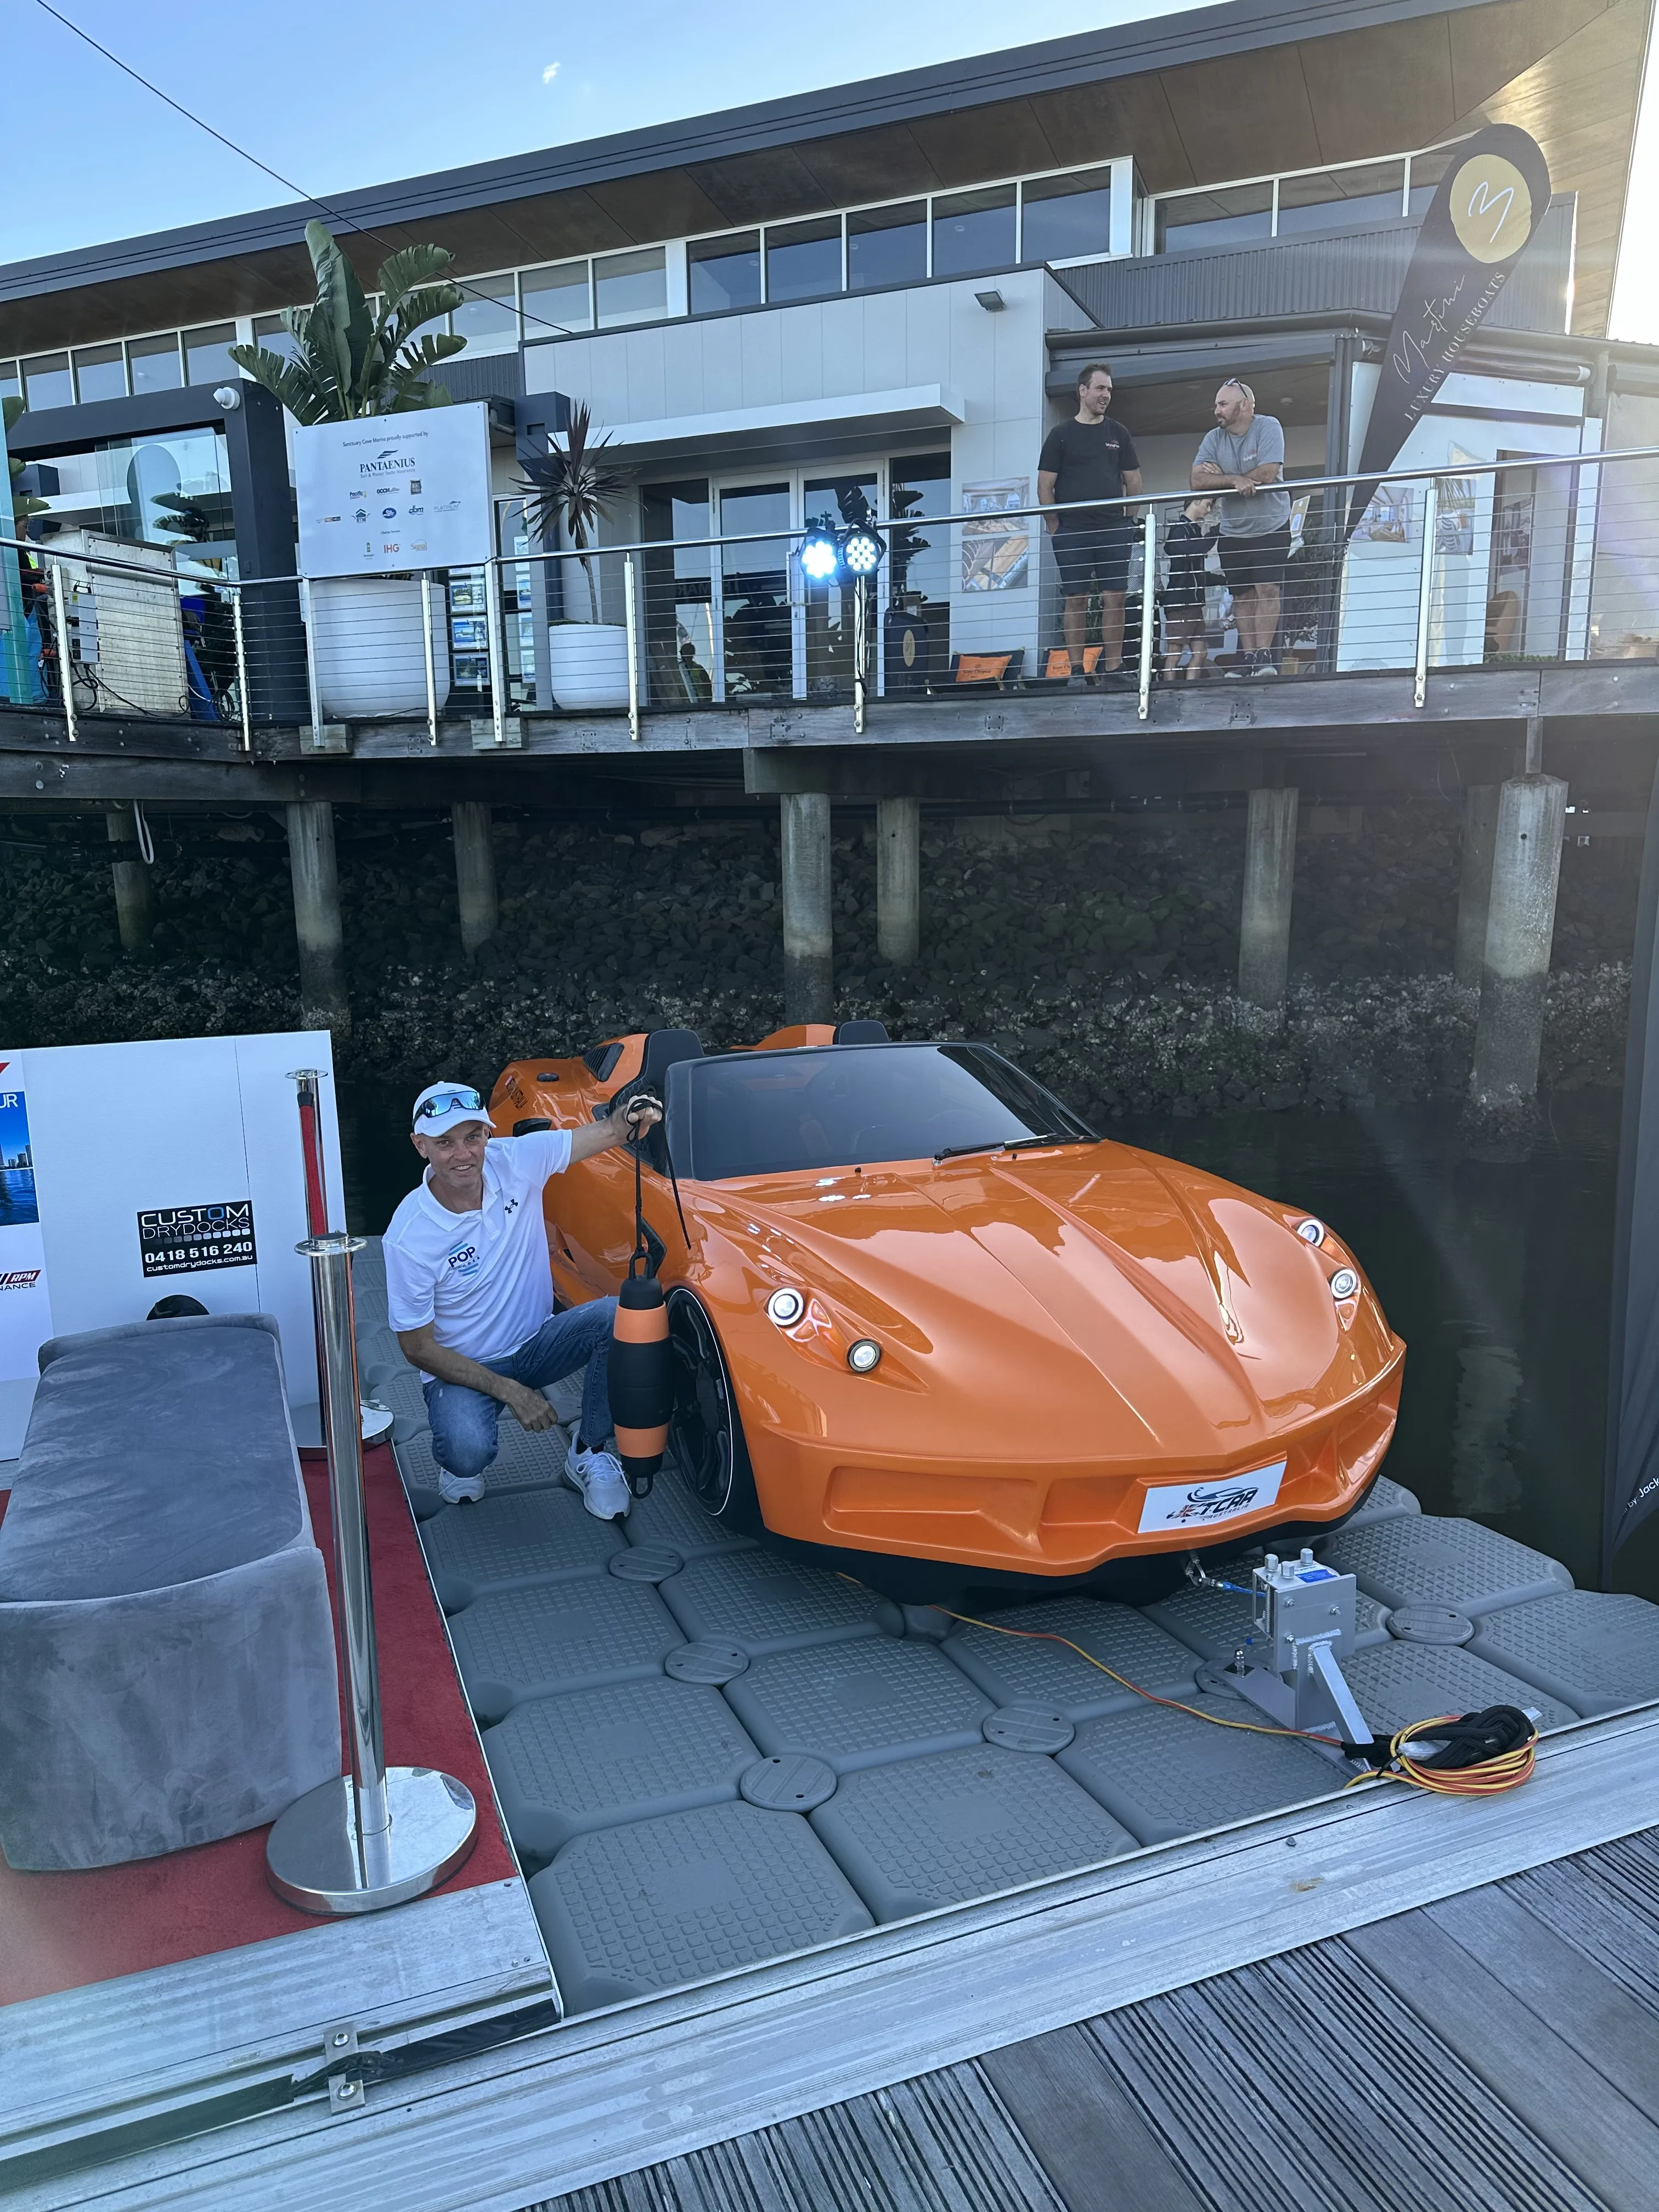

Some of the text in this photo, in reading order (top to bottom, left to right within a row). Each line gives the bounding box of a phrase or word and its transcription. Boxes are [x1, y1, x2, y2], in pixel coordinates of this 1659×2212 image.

[1393, 274, 1465, 384] Martini
[1404, 272, 1505, 421] LUXURY HOUSEBOATS
[402, 431, 422, 439] supported
[359, 457, 415, 472] PANTAENIUS
[384, 543, 400, 554] IHG
[141, 1203, 249, 1227] CUSTOM
[142, 1217, 250, 1239] DRYDOCKS
[145, 1242, 252, 1263] 0418 516 240
[448, 1246, 476, 1268] POP
[146, 1255, 253, 1272] customdrydocks.com.au
[10, 1272, 37, 1282] RPM
[1207, 1504, 1249, 1519] AUSTRALIA
